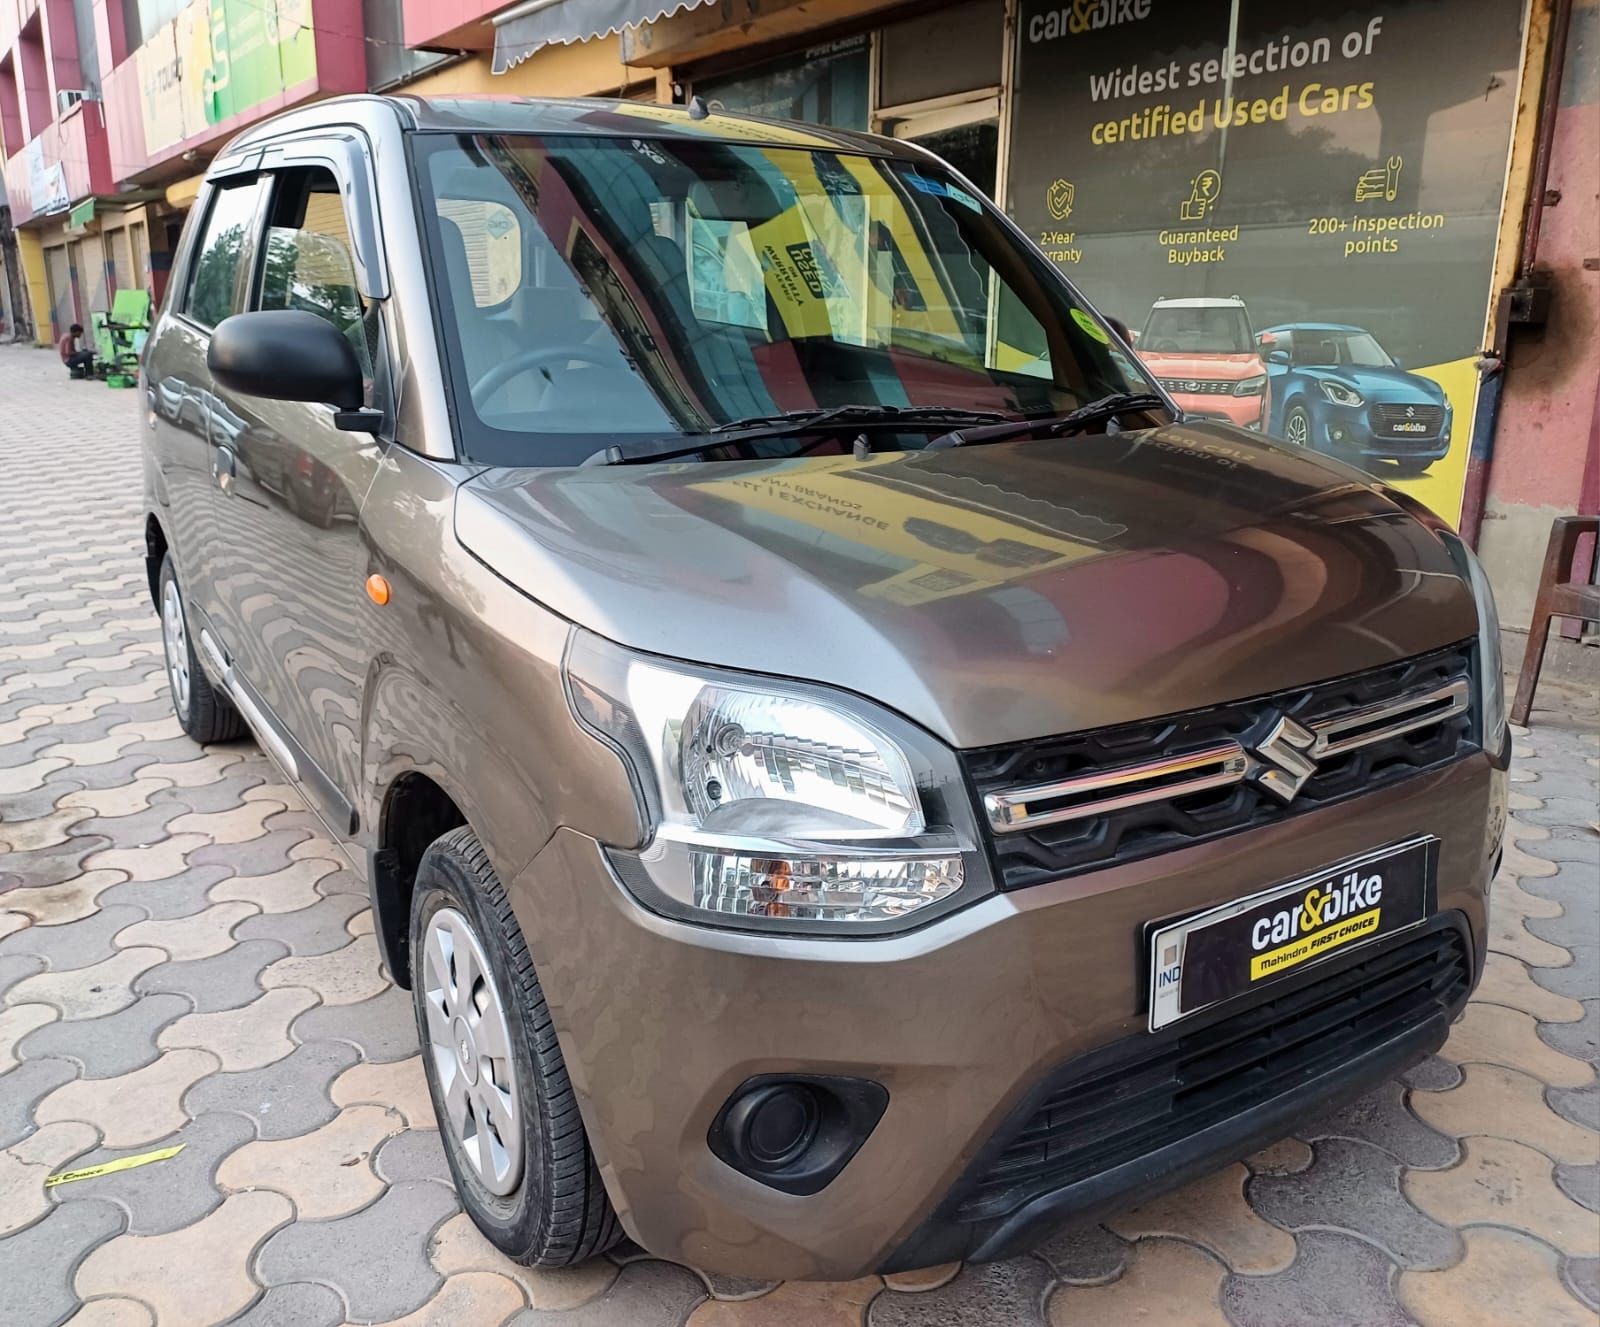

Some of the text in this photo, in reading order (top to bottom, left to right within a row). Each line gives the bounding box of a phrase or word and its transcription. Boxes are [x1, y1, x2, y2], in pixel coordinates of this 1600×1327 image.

[1089, 16, 1383, 102] Widest selection of
[1091, 82, 1375, 145] certified Used Cars
[1308, 211, 1445, 235] 200+ inspection
[1040, 231, 1076, 246] 2-Year
[1158, 225, 1240, 246] Guaranteed
[1045, 247, 1082, 264] rranty
[1167, 246, 1225, 266] Buyback
[1344, 236, 1399, 258] points
[1251, 872, 1382, 951] car&bike
[1260, 916, 1375, 971] Mahindra FIRST CHOICE
[1159, 966, 1181, 988] IND
